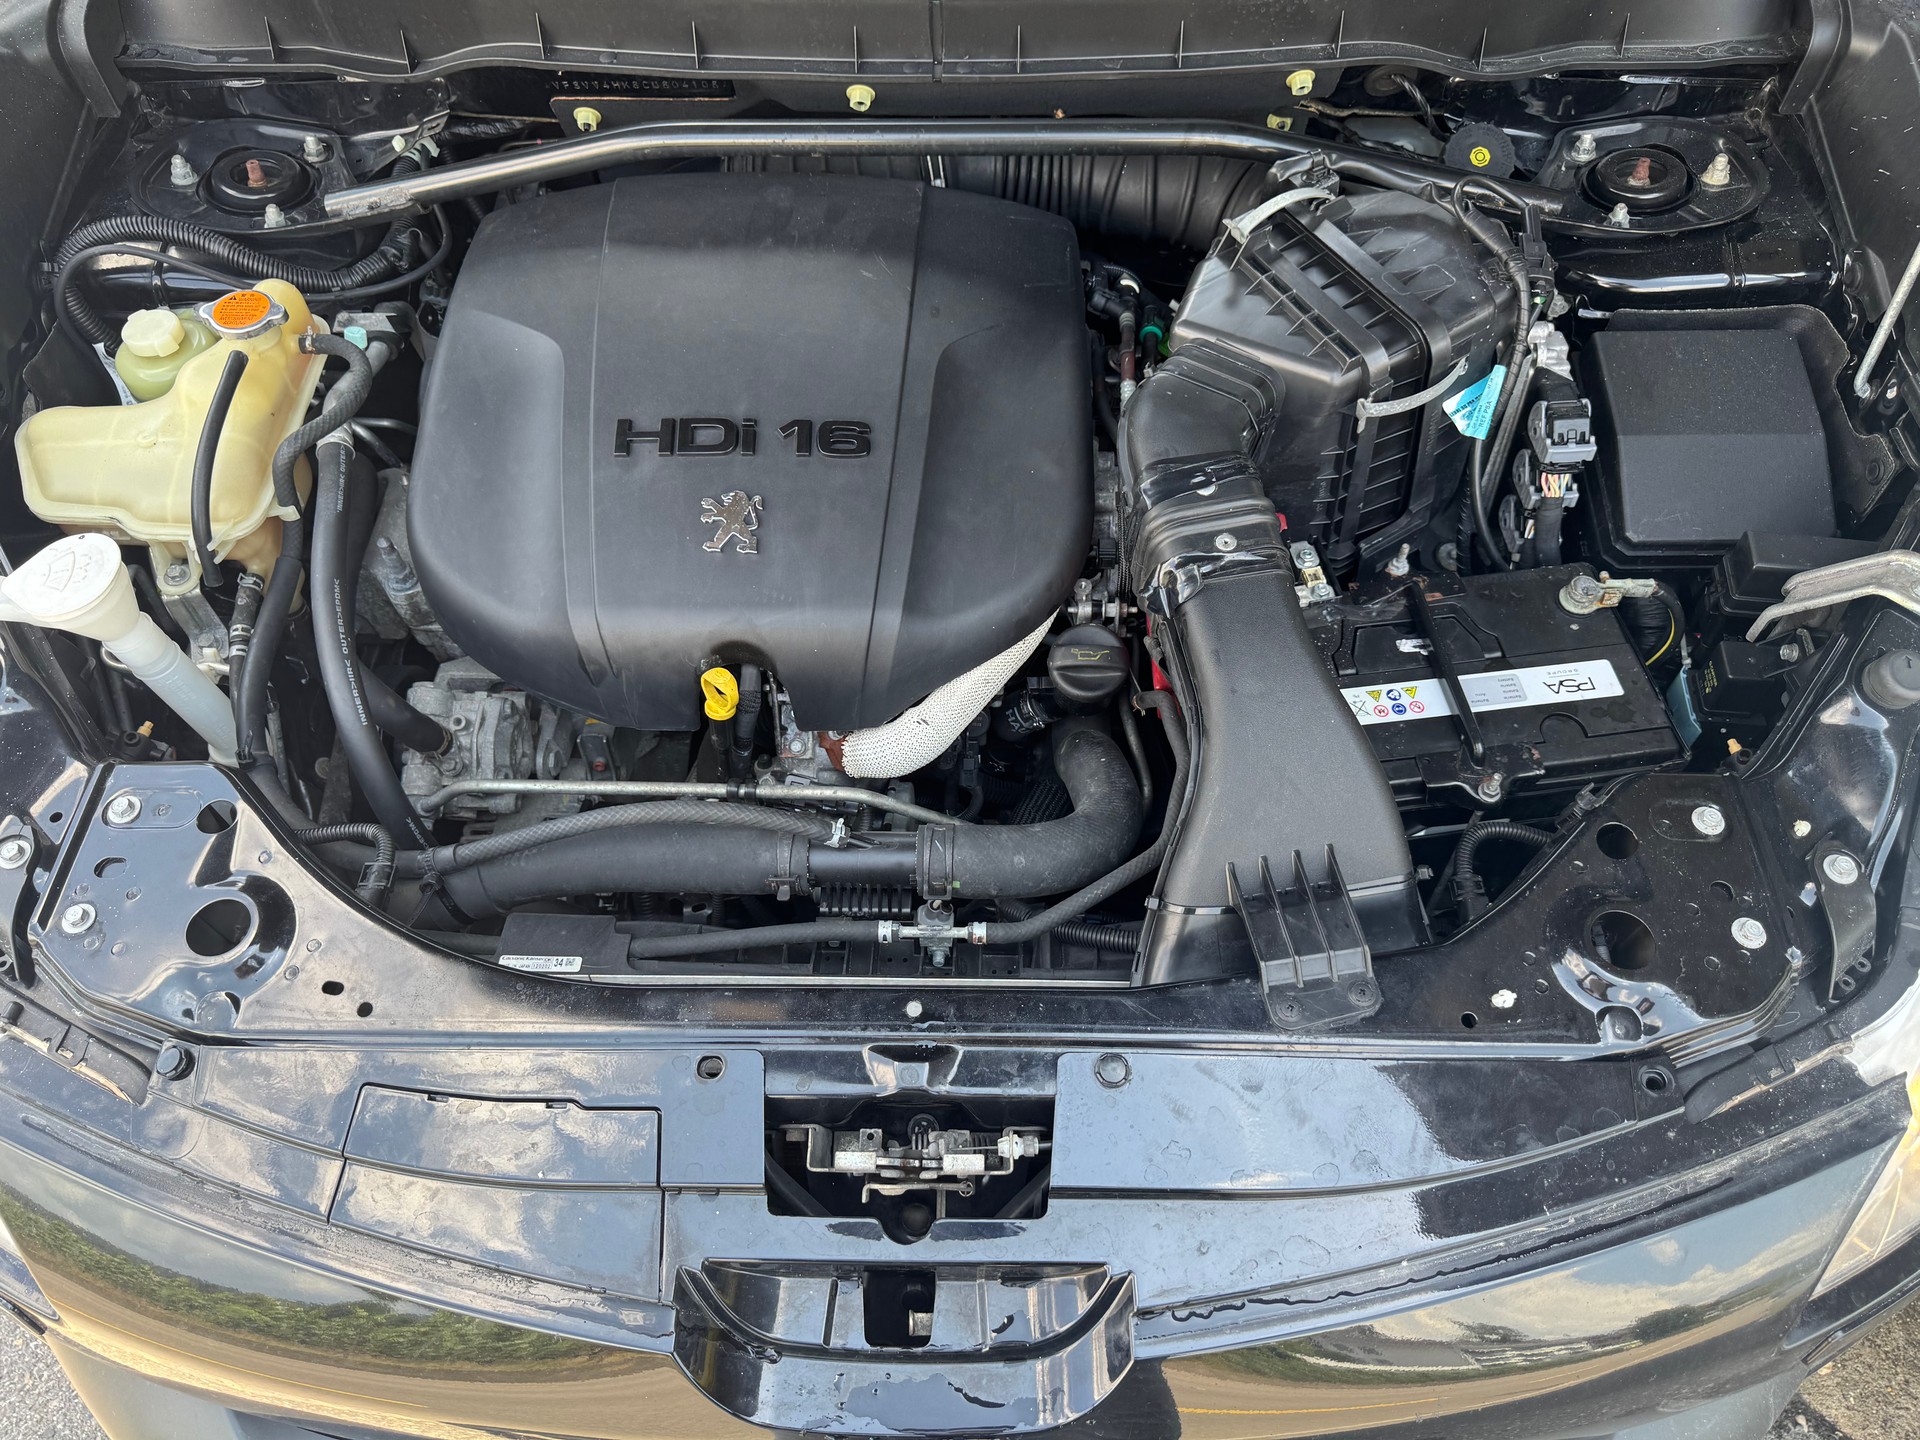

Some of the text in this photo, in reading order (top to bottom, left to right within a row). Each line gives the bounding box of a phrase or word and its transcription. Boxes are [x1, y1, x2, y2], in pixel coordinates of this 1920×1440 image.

[614, 418, 872, 459] HDi 16
[1542, 676, 1597, 696] PSA
[554, 958, 564, 967] 34
